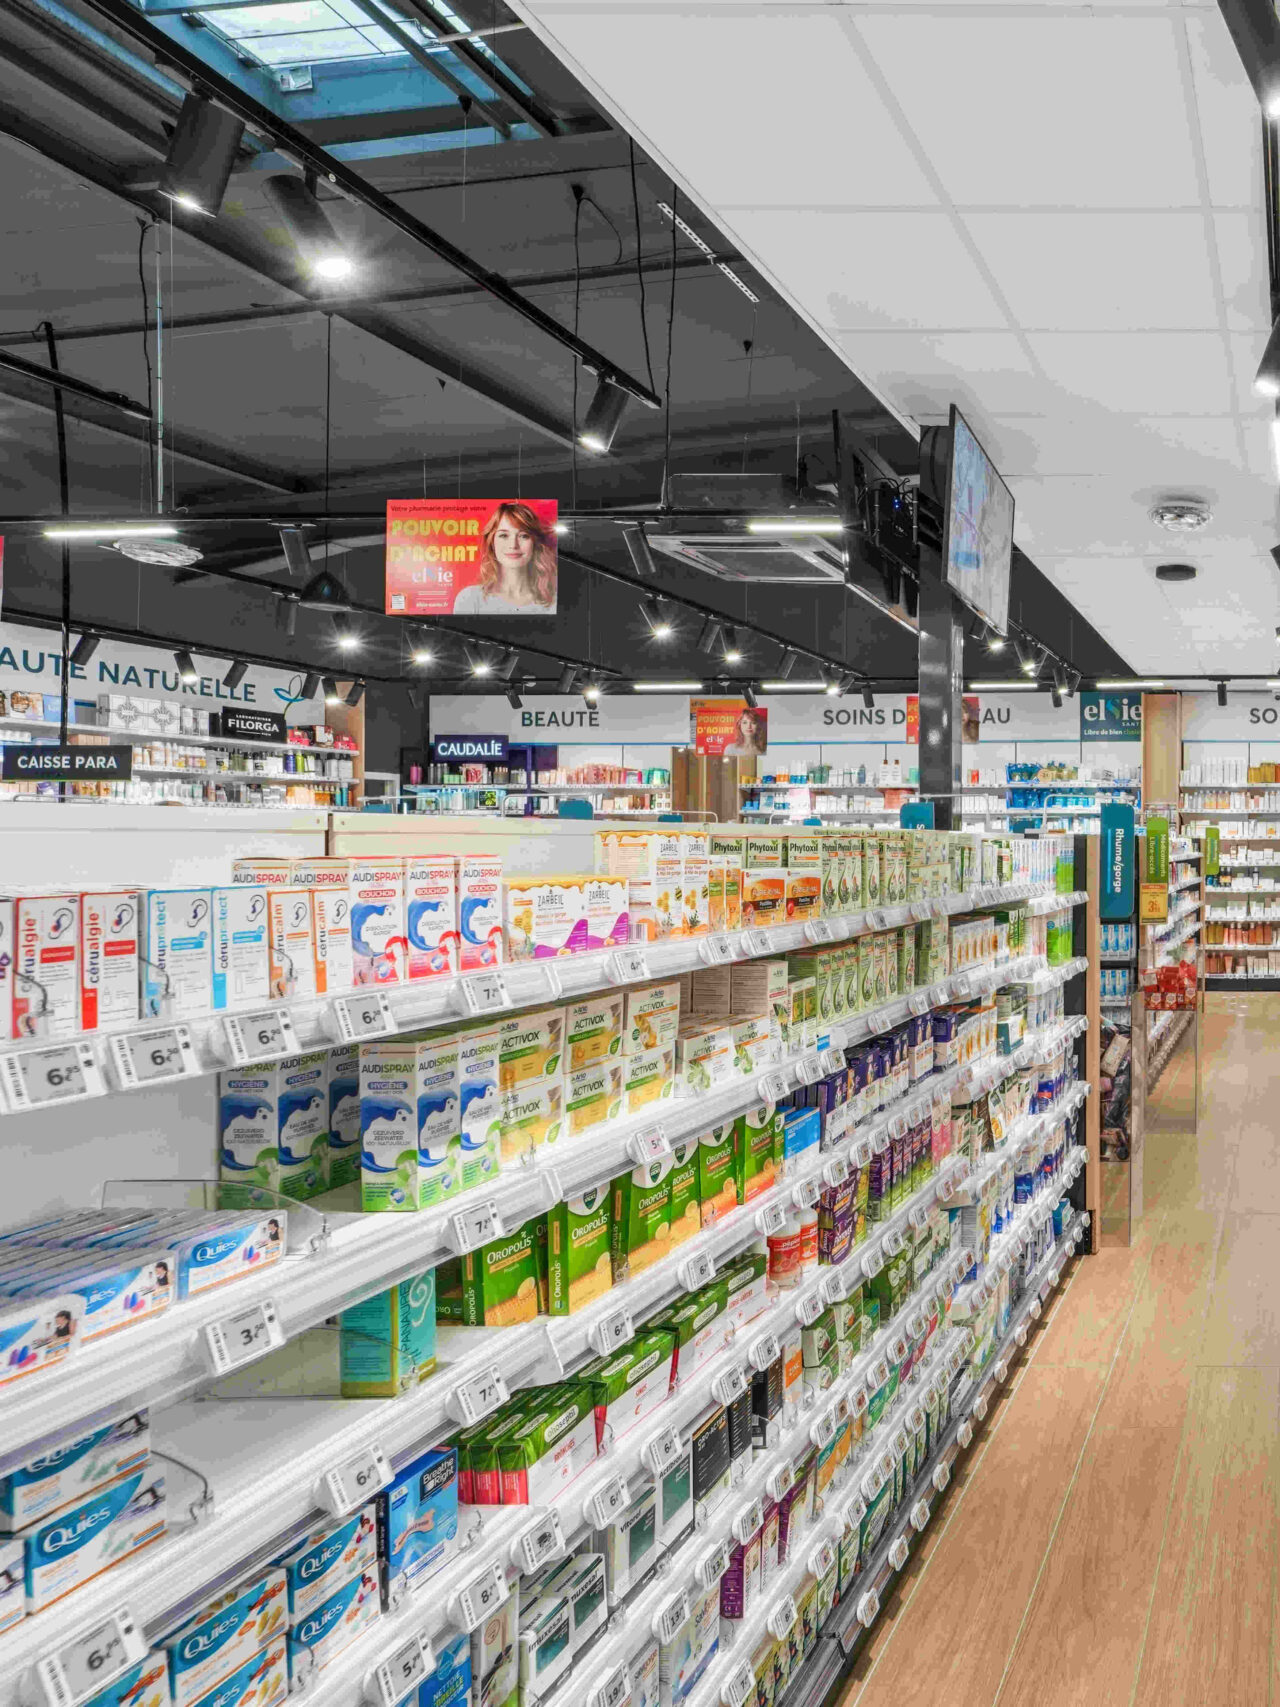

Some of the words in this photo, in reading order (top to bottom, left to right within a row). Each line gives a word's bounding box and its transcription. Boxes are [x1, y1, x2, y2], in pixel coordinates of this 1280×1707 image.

[391, 519, 480, 536] POUVOIR
[390, 546, 478, 562] D'ACHAT
[99, 661, 257, 703] NATURELLE
[228, 718, 280, 732] FILORGA
[823, 708, 886, 725] SOINS
[1109, 728, 1123, 736] bien
[17, 756, 71, 770] CAISSE
[75, 756, 117, 769] PARA
[714, 841, 742, 853] Phytoxil
[749, 841, 779, 853] Phytoxil
[789, 841, 819, 853] Phytoxil
[1113, 828, 1125, 893] Rhume/gorge
[233, 873, 287, 883] AUDISPRAY
[293, 873, 348, 884] AUDISPRAY
[352, 871, 402, 882] AUDISPRAY
[409, 869, 455, 880] AUDISPRAY
[463, 868, 502, 878] AUDISPRAY
[360, 890, 395, 898] BOUCHON
[85, 912, 102, 984] cérualgie
[638, 1000, 666, 1013] ACTIVOX
[574, 1013, 605, 1030] ACTIVOX
[501, 1030, 541, 1050] ACTIVOX
[330, 1045, 360, 1058] AUDISP
[461, 1042, 499, 1060] AUDISPRAY
[279, 1052, 328, 1071] AUDISPRAY
[362, 1063, 414, 1074] AUDISPRAY
[418, 1052, 459, 1072] AUDISPRAY
[630, 1060, 659, 1078] ACTIVOX
[572, 1079, 604, 1098] ACTIVOX
[502, 1100, 541, 1121] ACTIVOX
[706, 1147, 732, 1165] OROPOLIS
[672, 1168, 696, 1185] ROPOLIS
[638, 1186, 670, 1210] OROPOLIS
[571, 1211, 609, 1241] OROPOLIS
[196, 1239, 238, 1263] Quies
[487, 1235, 534, 1265] OROPOLIS
[554, 1260, 562, 1298] OROPOLIS
[88, 1286, 116, 1307] ies
[469, 1288, 477, 1326] OROPOLIS
[25, 1430, 95, 1473] Quies
[422, 1456, 454, 1484] Breathe
[433, 1466, 454, 1489] Right
[43, 1504, 111, 1553] Quies
[301, 1541, 343, 1578] Quies
[300, 1601, 344, 1642] Quies
[184, 1612, 238, 1660] Quies
[528, 1613, 563, 1653] Imuxesal
